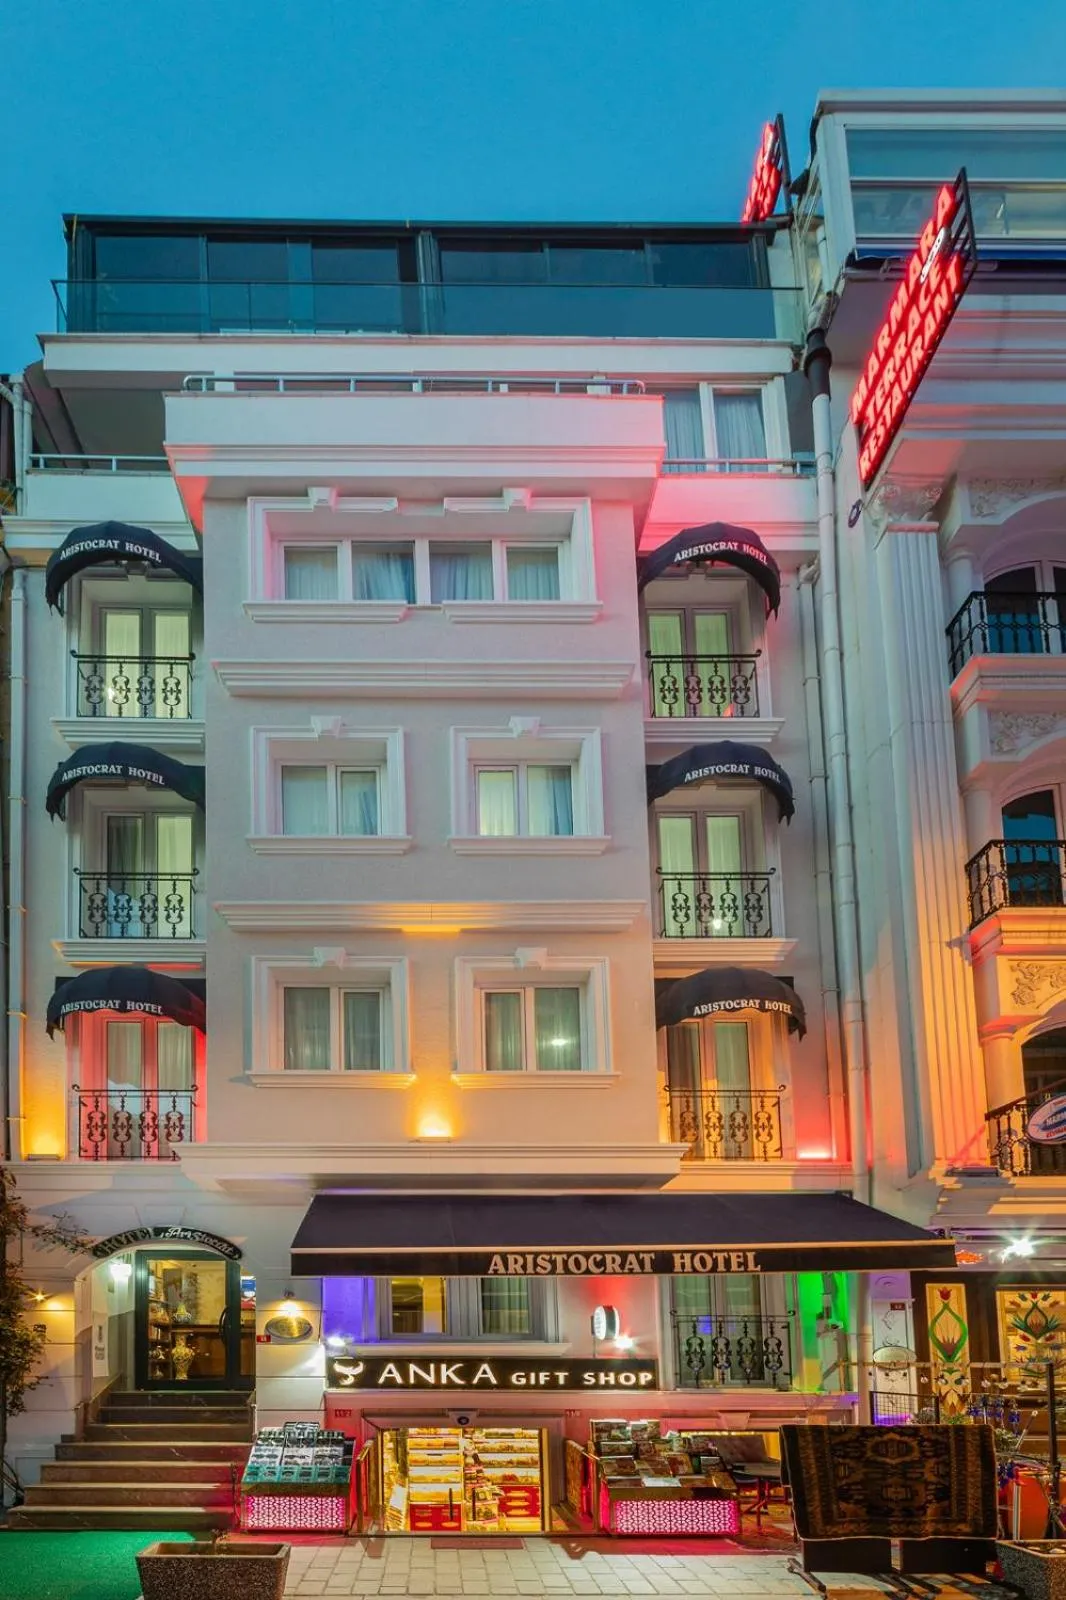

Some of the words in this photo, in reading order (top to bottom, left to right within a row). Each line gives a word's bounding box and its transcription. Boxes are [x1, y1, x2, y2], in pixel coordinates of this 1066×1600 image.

[864, 254, 943, 430] TERRACE
[859, 253, 962, 481] RESTAURANT
[60, 539, 120, 561] ARISTOCRAT
[125, 541, 162, 563] HOTEL
[673, 541, 739, 563] ARISTOCRAT
[742, 544, 768, 565] HOTEL
[61, 764, 123, 782] ARISTOCRAT
[128, 766, 165, 785] HOTEL
[684, 764, 750, 783] ARISTOCRAT
[754, 766, 781, 783] HOTEL
[60, 1000, 121, 1014] ARISTOCRAT
[126, 1001, 163, 1015] HOTEL
[693, 999, 761, 1016] ARISTOCRAT
[765, 1000, 792, 1014] HOTEL
[488, 1252, 655, 1275] ARISTOCRAT
[672, 1251, 761, 1273] HOTEL
[377, 1362, 497, 1386] ANKA
[511, 1371, 569, 1386] GIFT
[583, 1371, 653, 1386] SHOP
